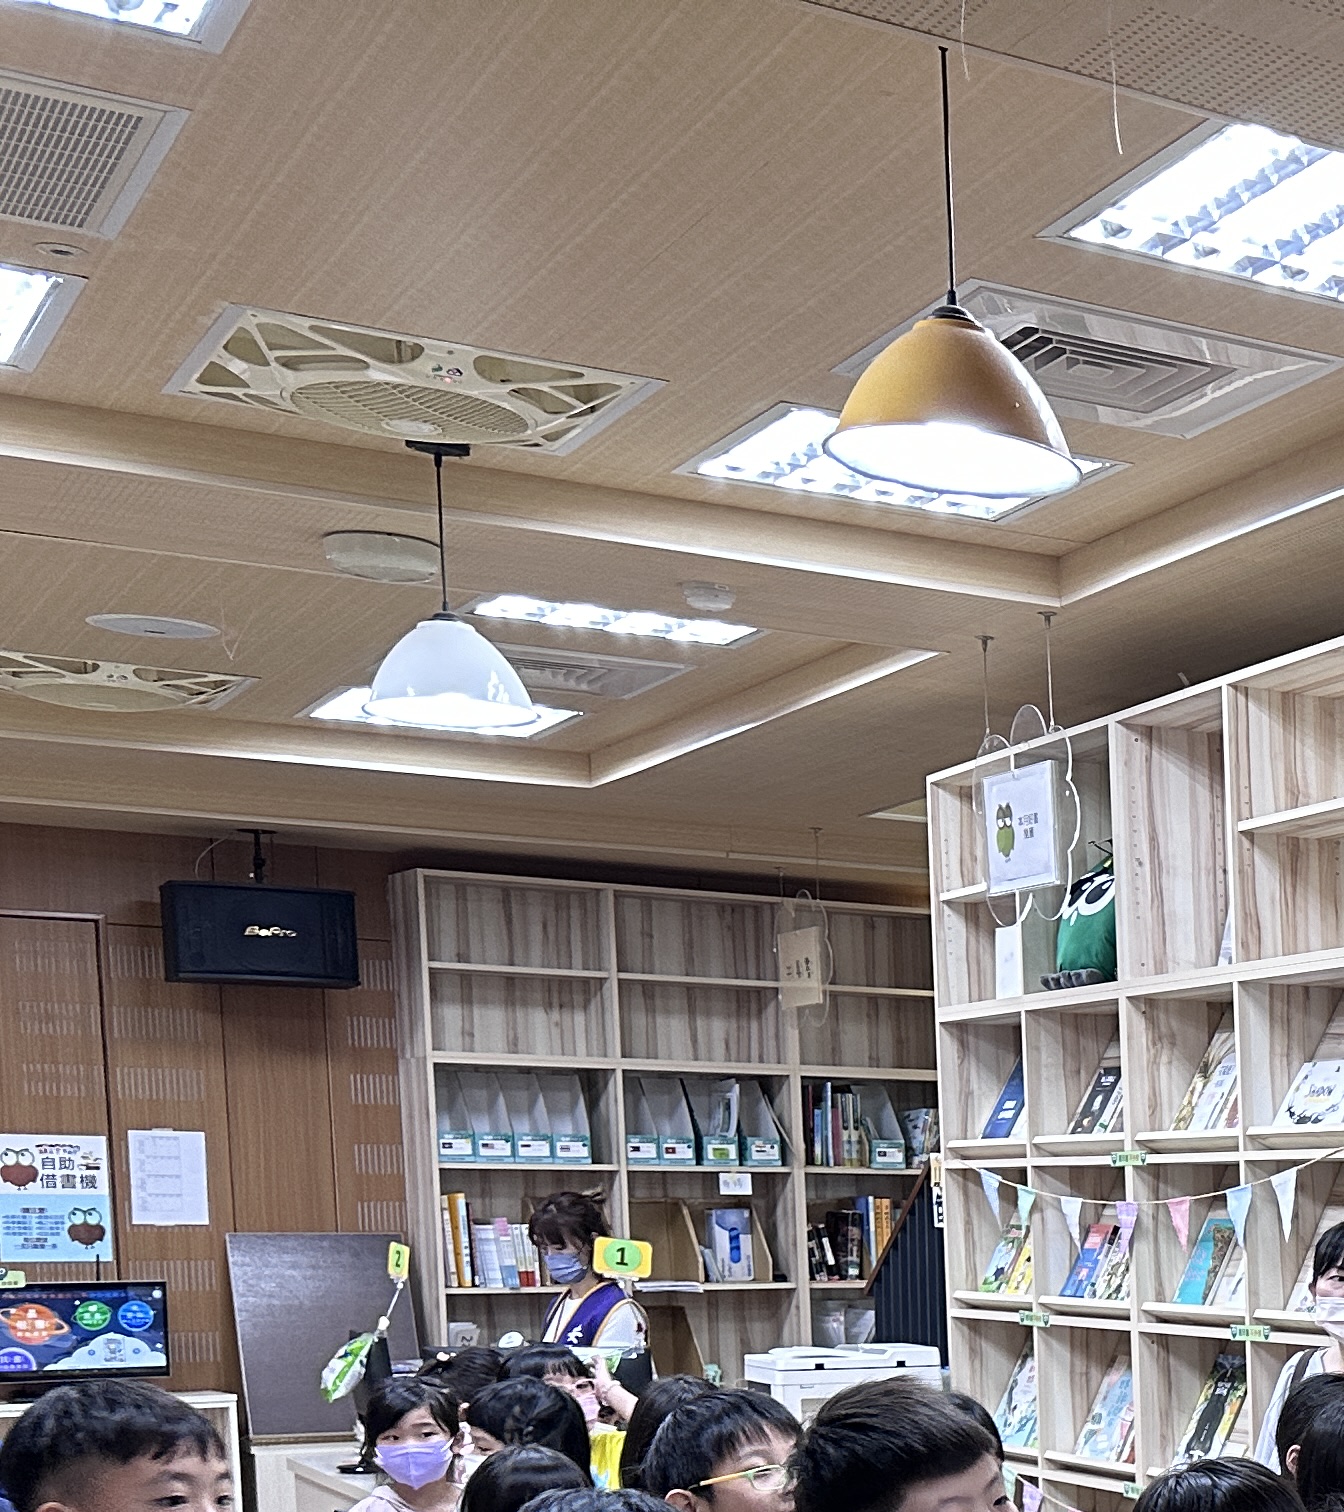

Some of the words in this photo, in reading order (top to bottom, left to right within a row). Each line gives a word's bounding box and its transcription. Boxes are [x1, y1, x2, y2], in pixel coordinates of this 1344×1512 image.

[41, 1157, 75, 1171] 自助
[40, 1174, 98, 1189] 借書機
[395, 1250, 402, 1268] 2
[615, 1247, 629, 1267] 1
